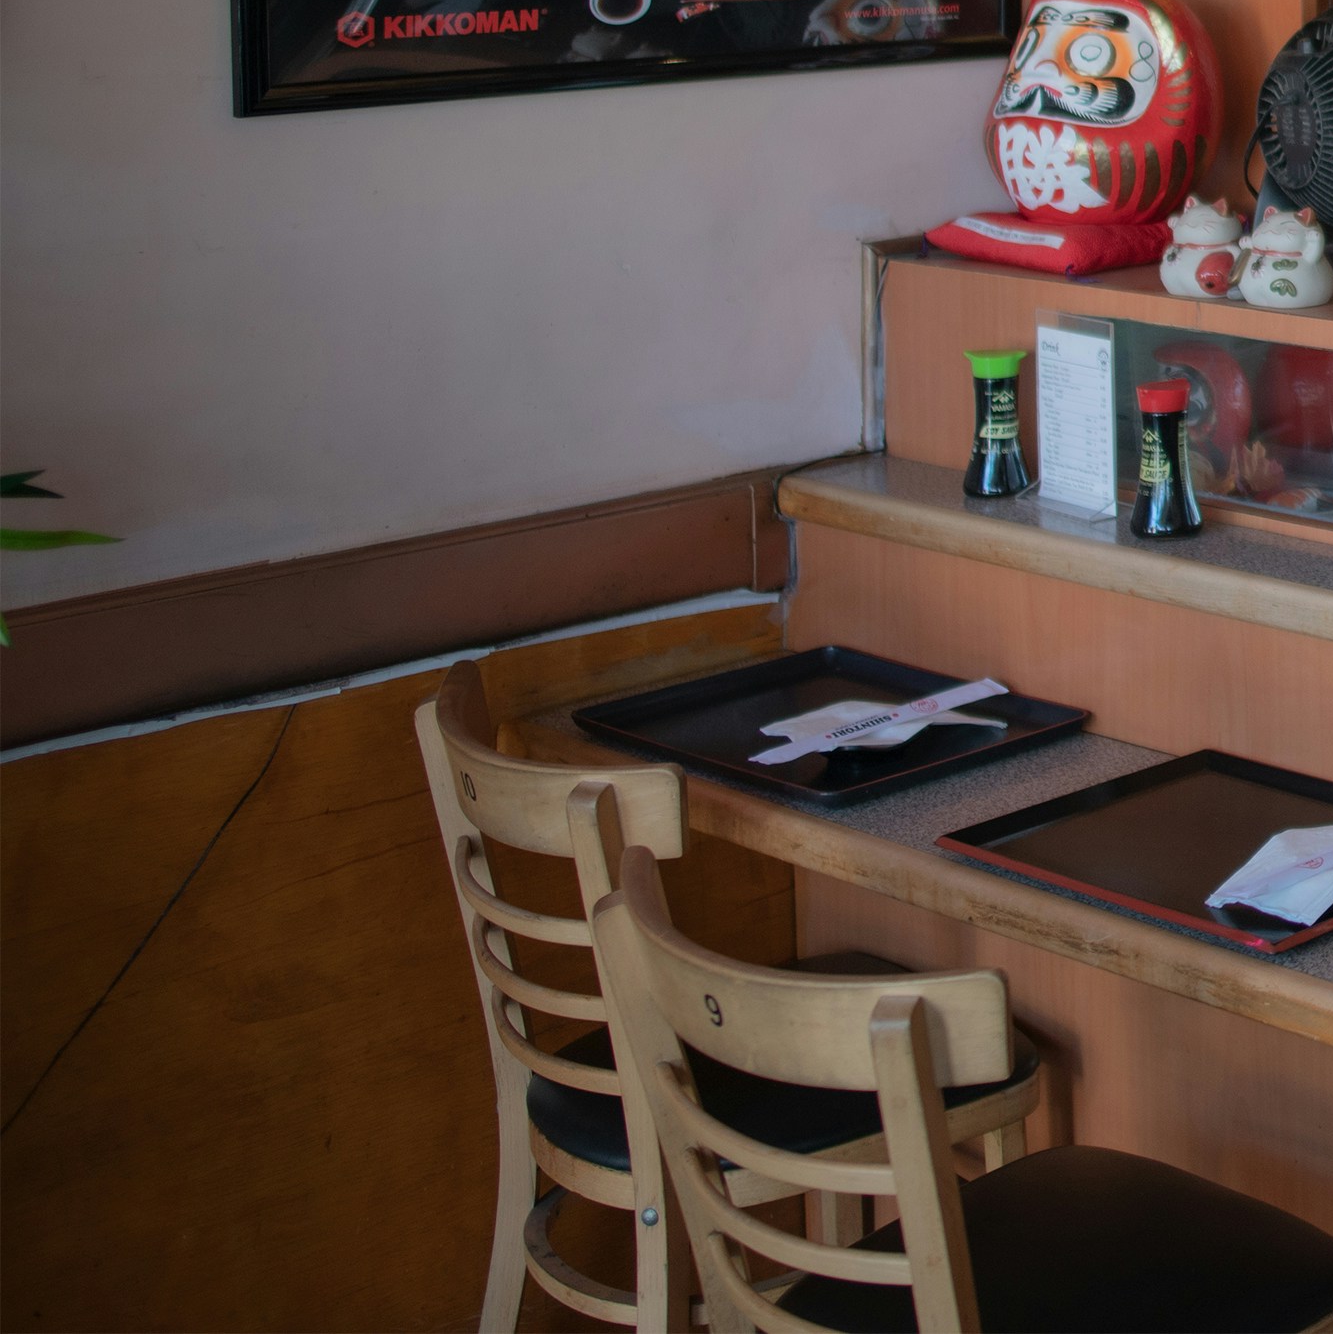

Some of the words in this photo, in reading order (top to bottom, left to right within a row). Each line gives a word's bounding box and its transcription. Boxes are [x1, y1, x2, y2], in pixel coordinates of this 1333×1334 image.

[384, 9, 539, 39] KIKKOMAN
[1042, 341, 1060, 356] Drink
[1002, 426, 1019, 434] SAUC
[832, 715, 892, 738] SHINTORI
[704, 992, 723, 1028] 9
